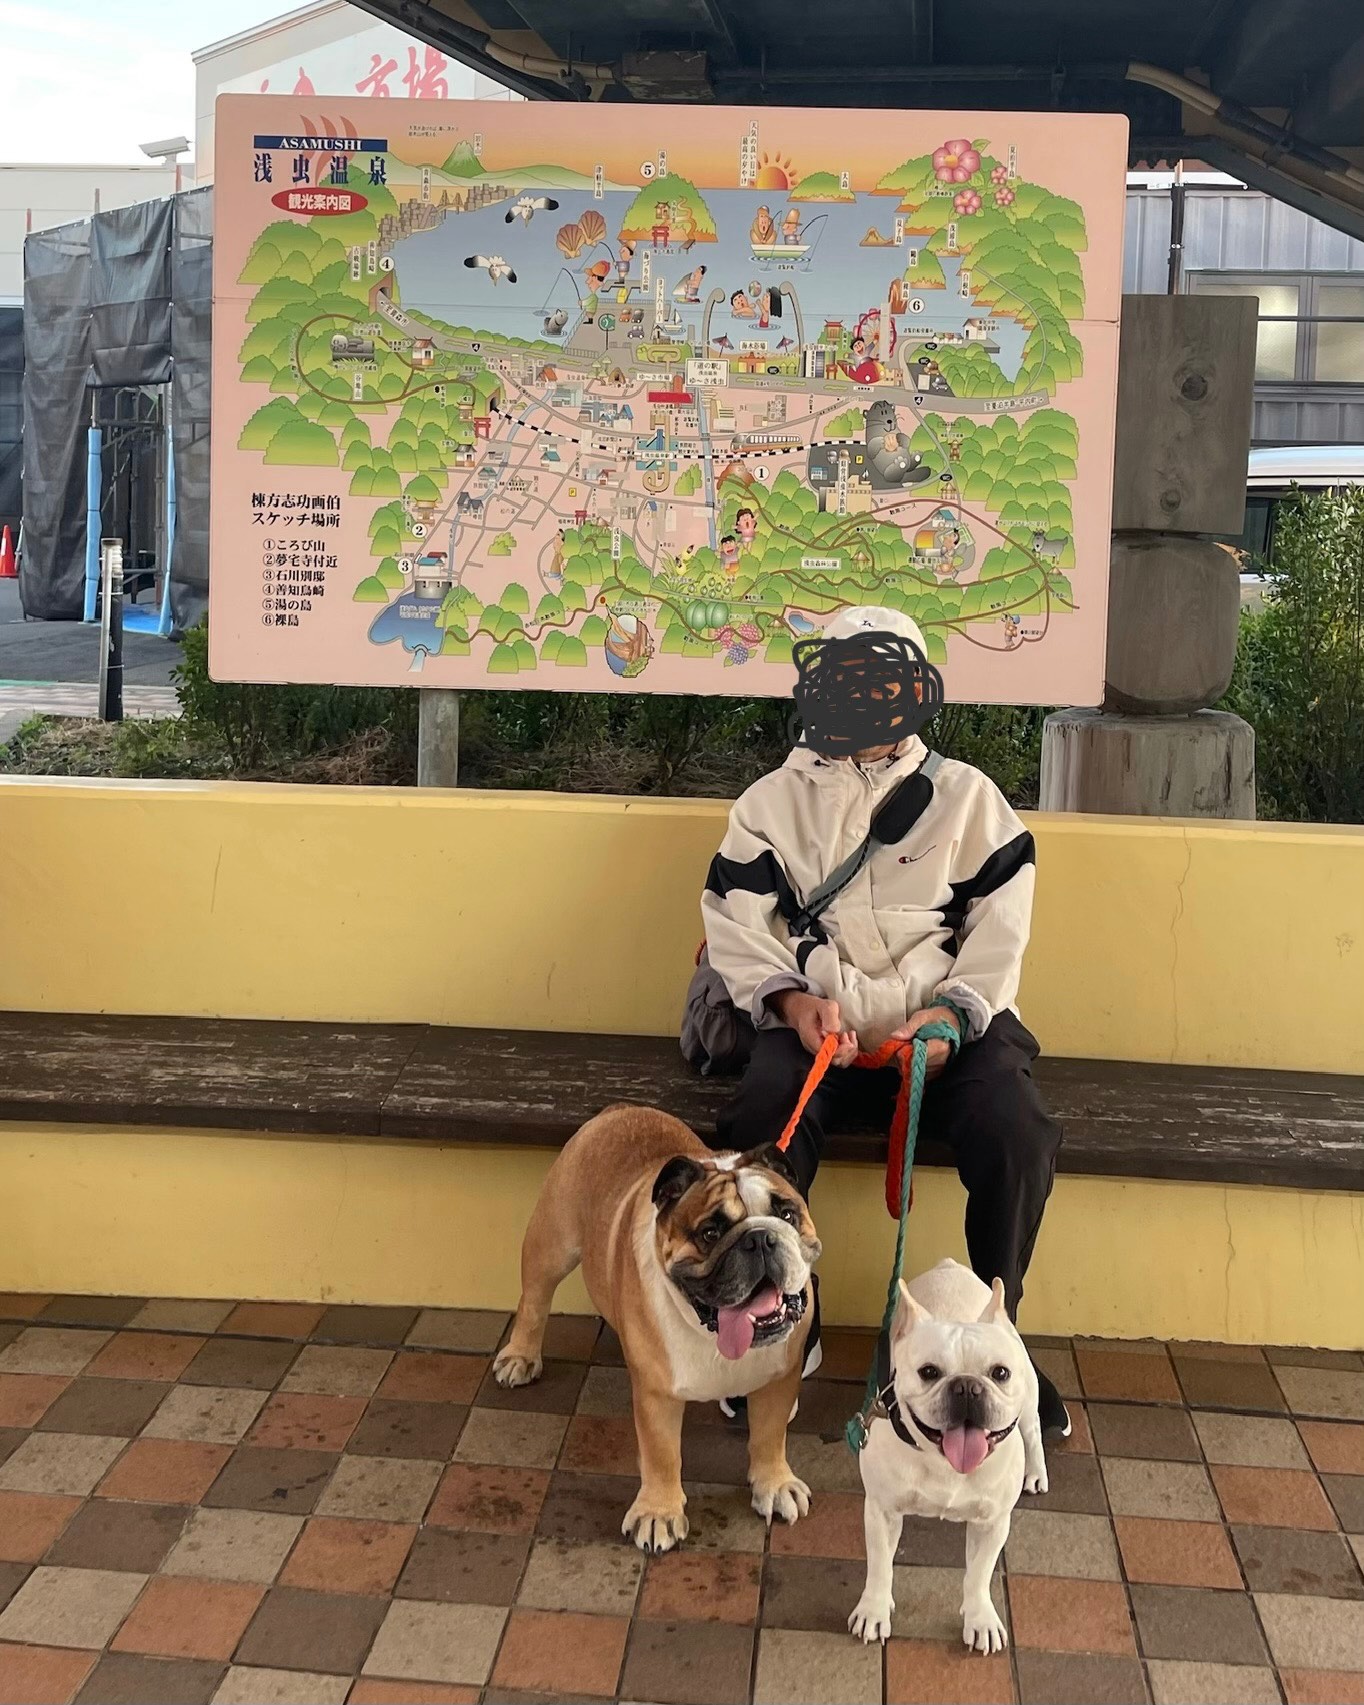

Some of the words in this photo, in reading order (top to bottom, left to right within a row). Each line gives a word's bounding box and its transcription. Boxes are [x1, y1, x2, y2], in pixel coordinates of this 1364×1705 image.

[279, 138, 362, 151] ASAMUSHI
[253, 153, 388, 186] 浅虫温泉
[842, 172, 848, 188] 大島
[287, 193, 352, 211] 観光案内図
[741, 342, 766, 350] 海水浴場
[692, 361, 721, 370] 「道の駅」
[251, 492, 341, 511] 棟方志功画伯
[251, 511, 341, 528] スケッチ場所
[262, 538, 326, 552] ①ころび山
[262, 553, 338, 569] ②夢宅寺付近
[262, 569, 326, 583] ③石川別邸
[261, 583, 325, 598] ④善知鳥崎
[261, 598, 312, 612] ⑤湯の島
[261, 612, 300, 627] ⑥裸島
